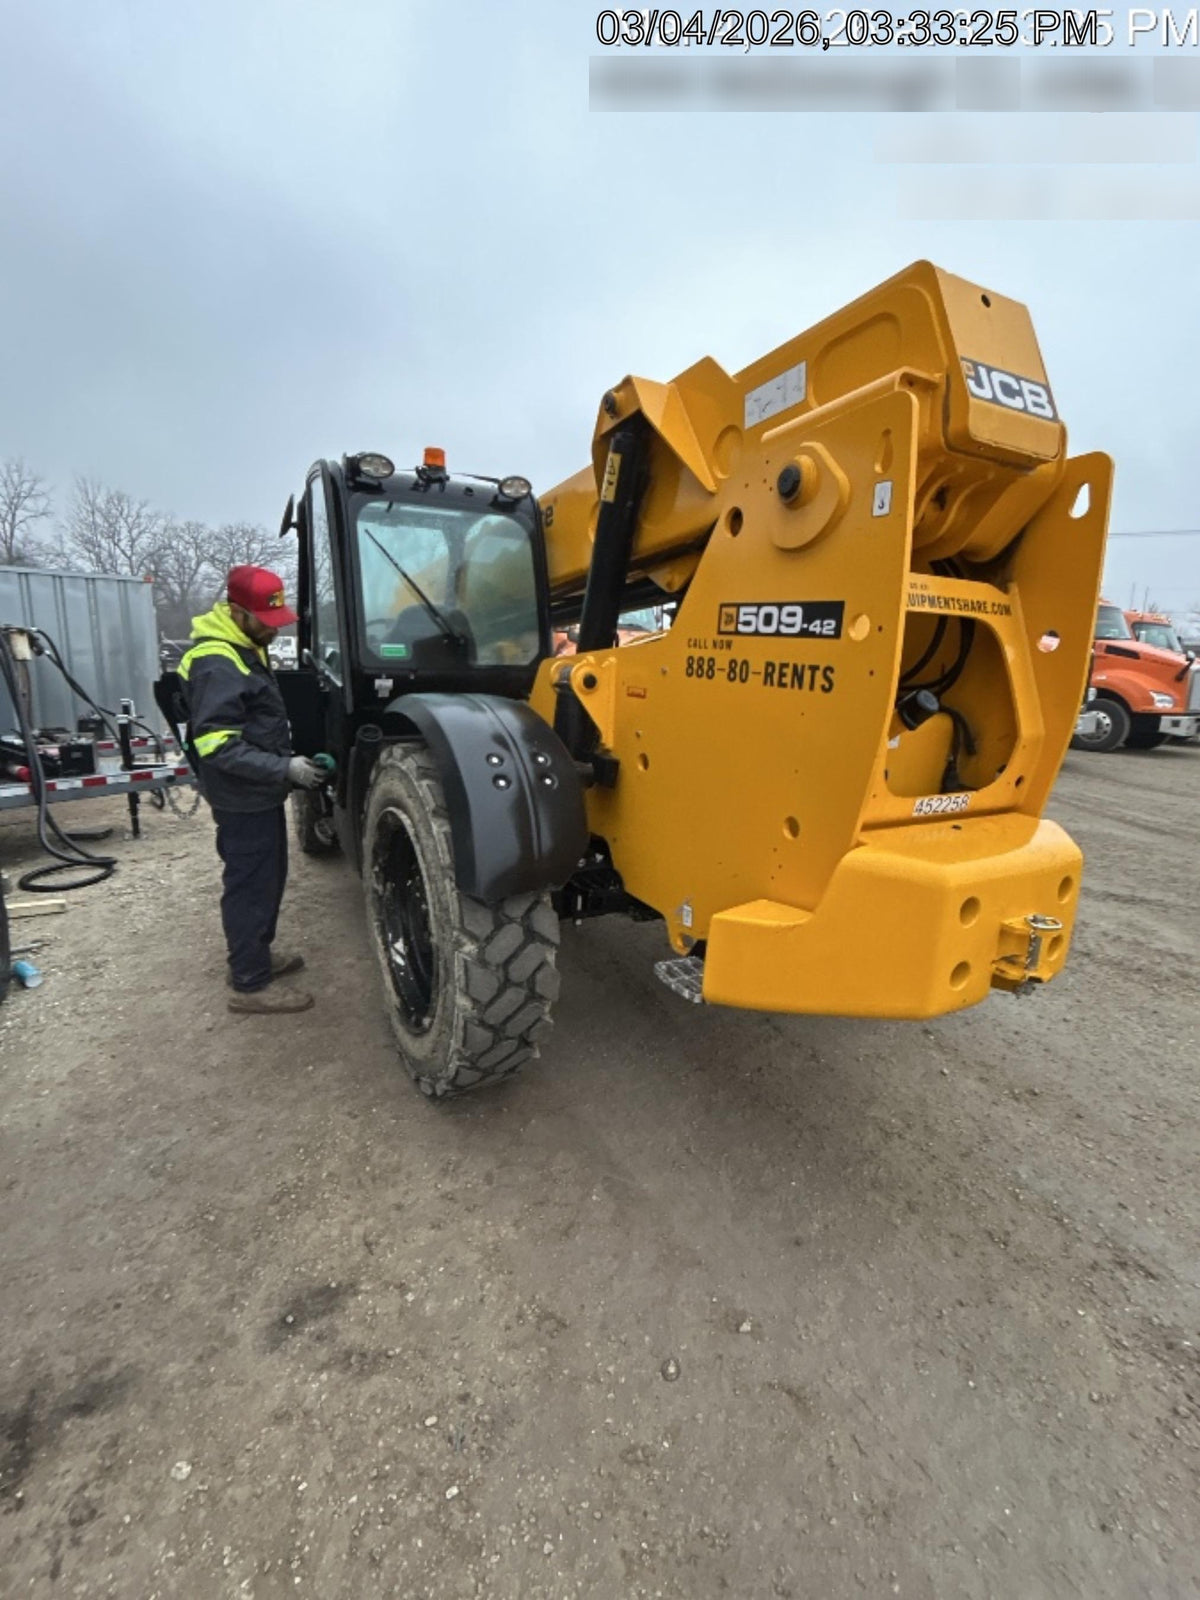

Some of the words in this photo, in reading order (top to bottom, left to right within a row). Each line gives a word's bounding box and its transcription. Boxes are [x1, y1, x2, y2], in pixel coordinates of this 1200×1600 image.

[966, 365, 1054, 419] JCB
[906, 592, 1012, 616] UIPMENTSHARE.COM
[737, 605, 837, 636] 509-42
[687, 638, 708, 650] CALL
[712, 639, 733, 651] NOW
[685, 655, 835, 694] 888-80-RENTS
